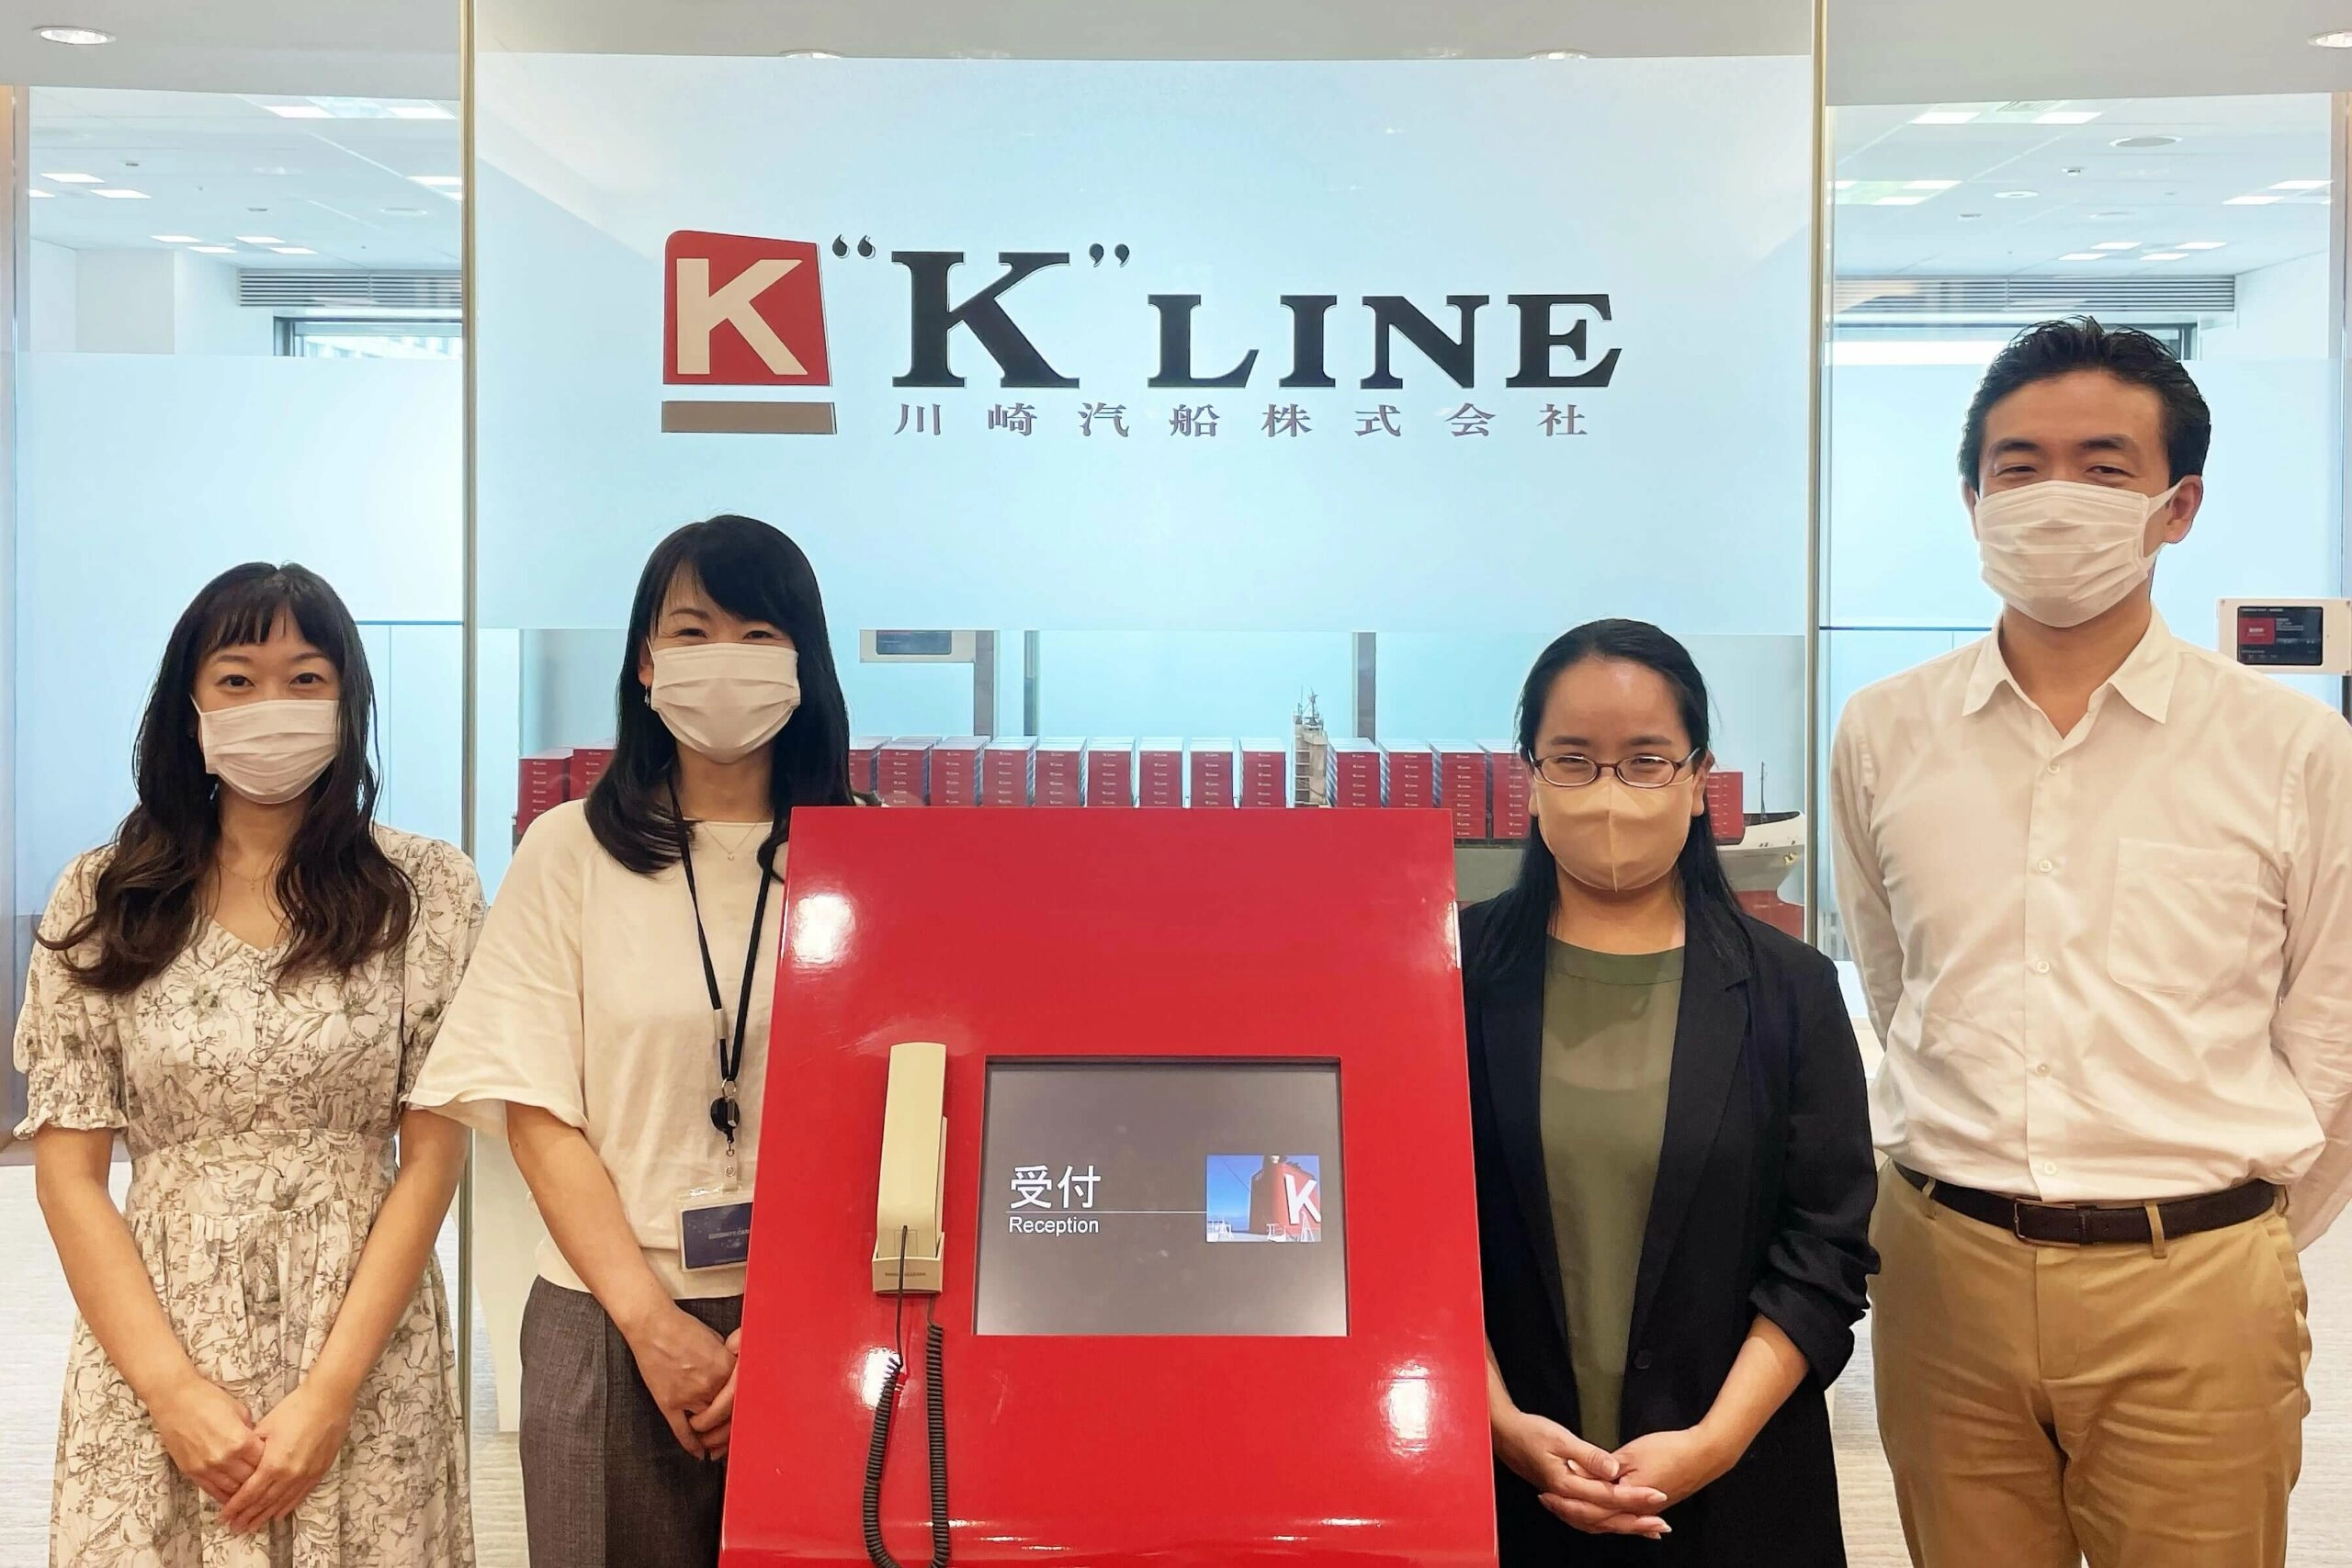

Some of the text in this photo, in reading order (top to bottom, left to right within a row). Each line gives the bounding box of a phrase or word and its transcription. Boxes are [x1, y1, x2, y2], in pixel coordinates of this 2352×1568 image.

[676, 258, 808, 375] K
[1147, 294, 1623, 389] LINE
[894, 401, 1589, 438] 川崎汽船株式会社
[1010, 1165, 1102, 1209] 受付
[1009, 1216, 1100, 1237] Reception
